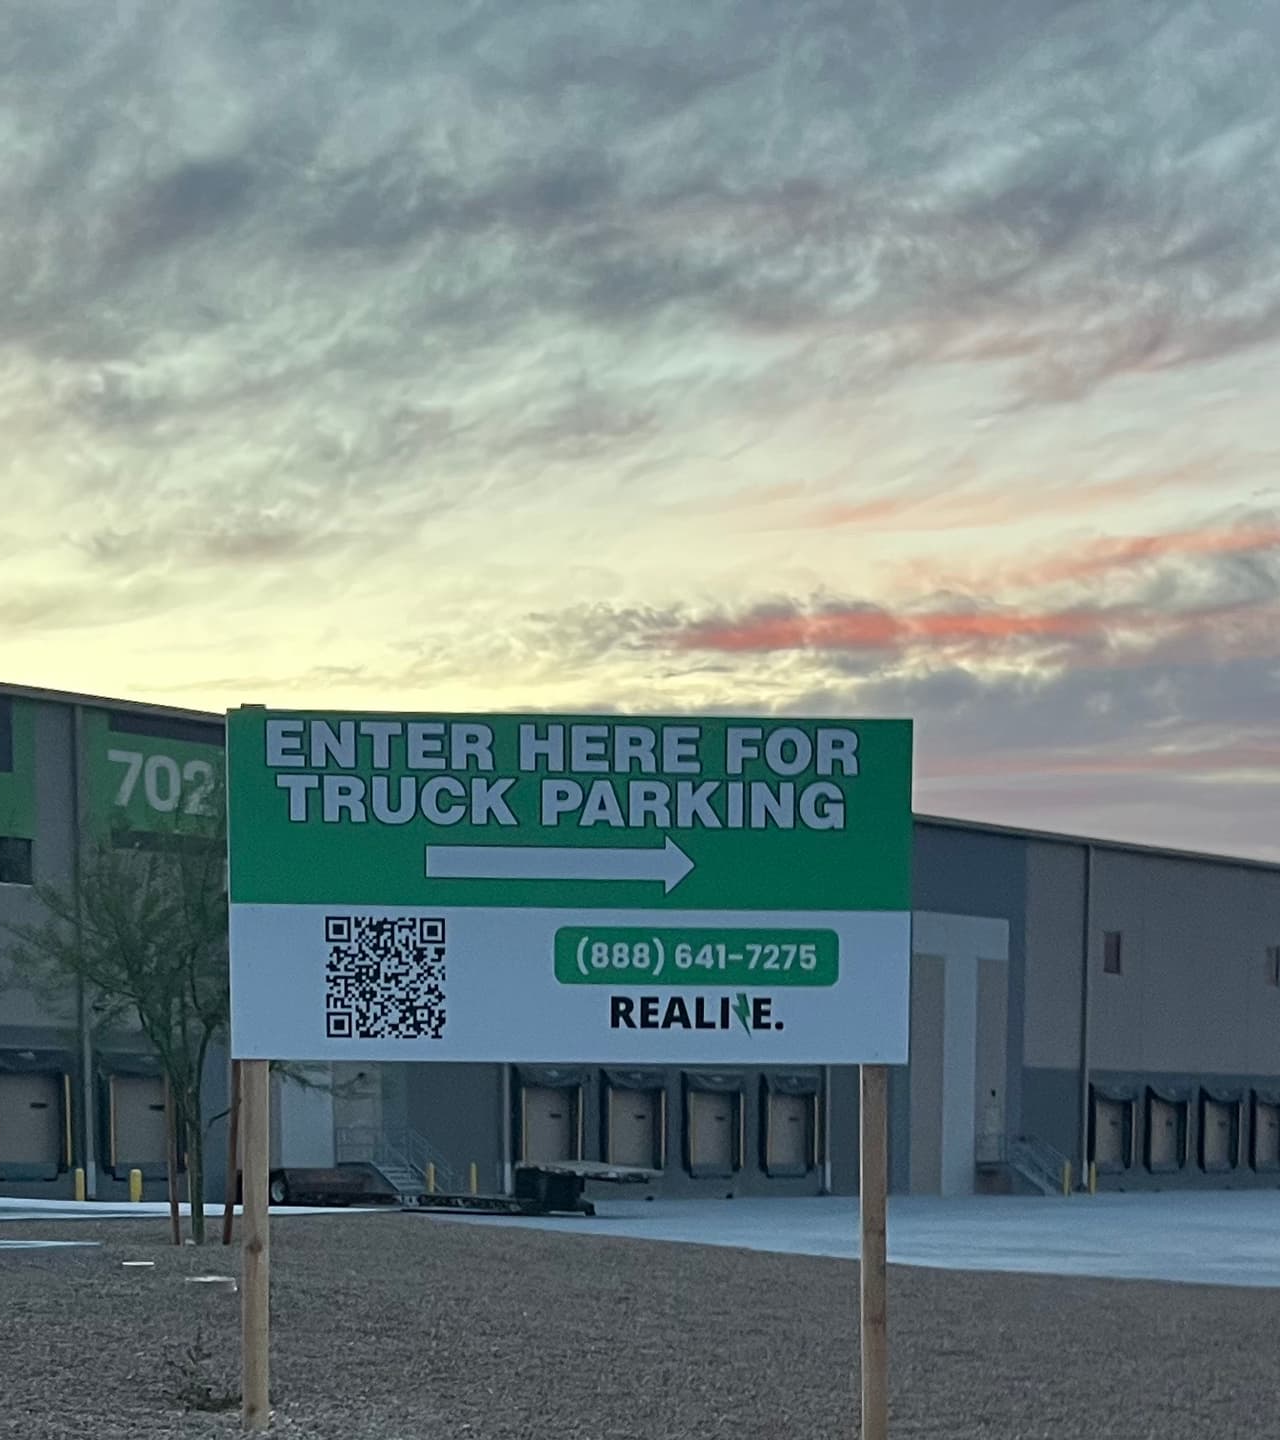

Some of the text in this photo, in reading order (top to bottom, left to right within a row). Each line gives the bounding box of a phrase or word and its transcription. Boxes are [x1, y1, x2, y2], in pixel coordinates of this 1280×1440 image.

[264, 719, 859, 776] ENTER HERE FOR
[107, 749, 219, 817] 702
[276, 774, 846, 830] TRUCK PARKING
[576, 936, 817, 976] (888) 641-7275
